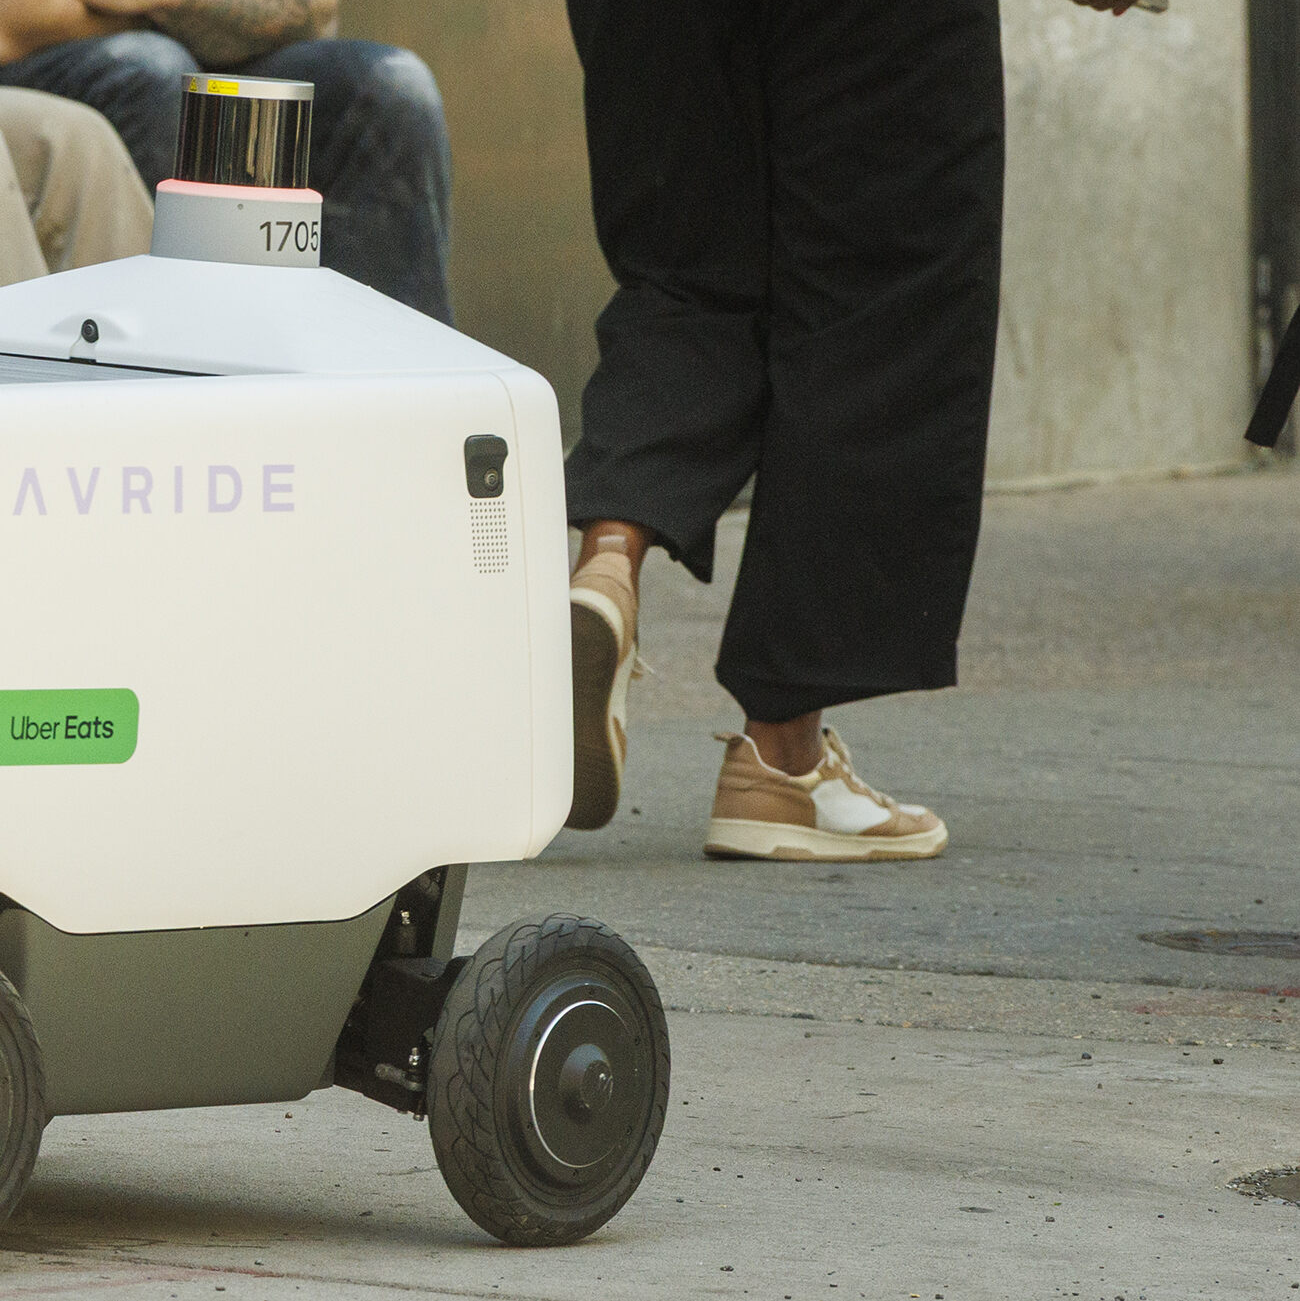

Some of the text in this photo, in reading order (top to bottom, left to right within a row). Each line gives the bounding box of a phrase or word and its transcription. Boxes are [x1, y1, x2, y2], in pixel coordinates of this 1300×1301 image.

[260, 221, 319, 252] 1705
[12, 464, 296, 516] AVRIDE
[11, 715, 115, 741] Uber Eats
